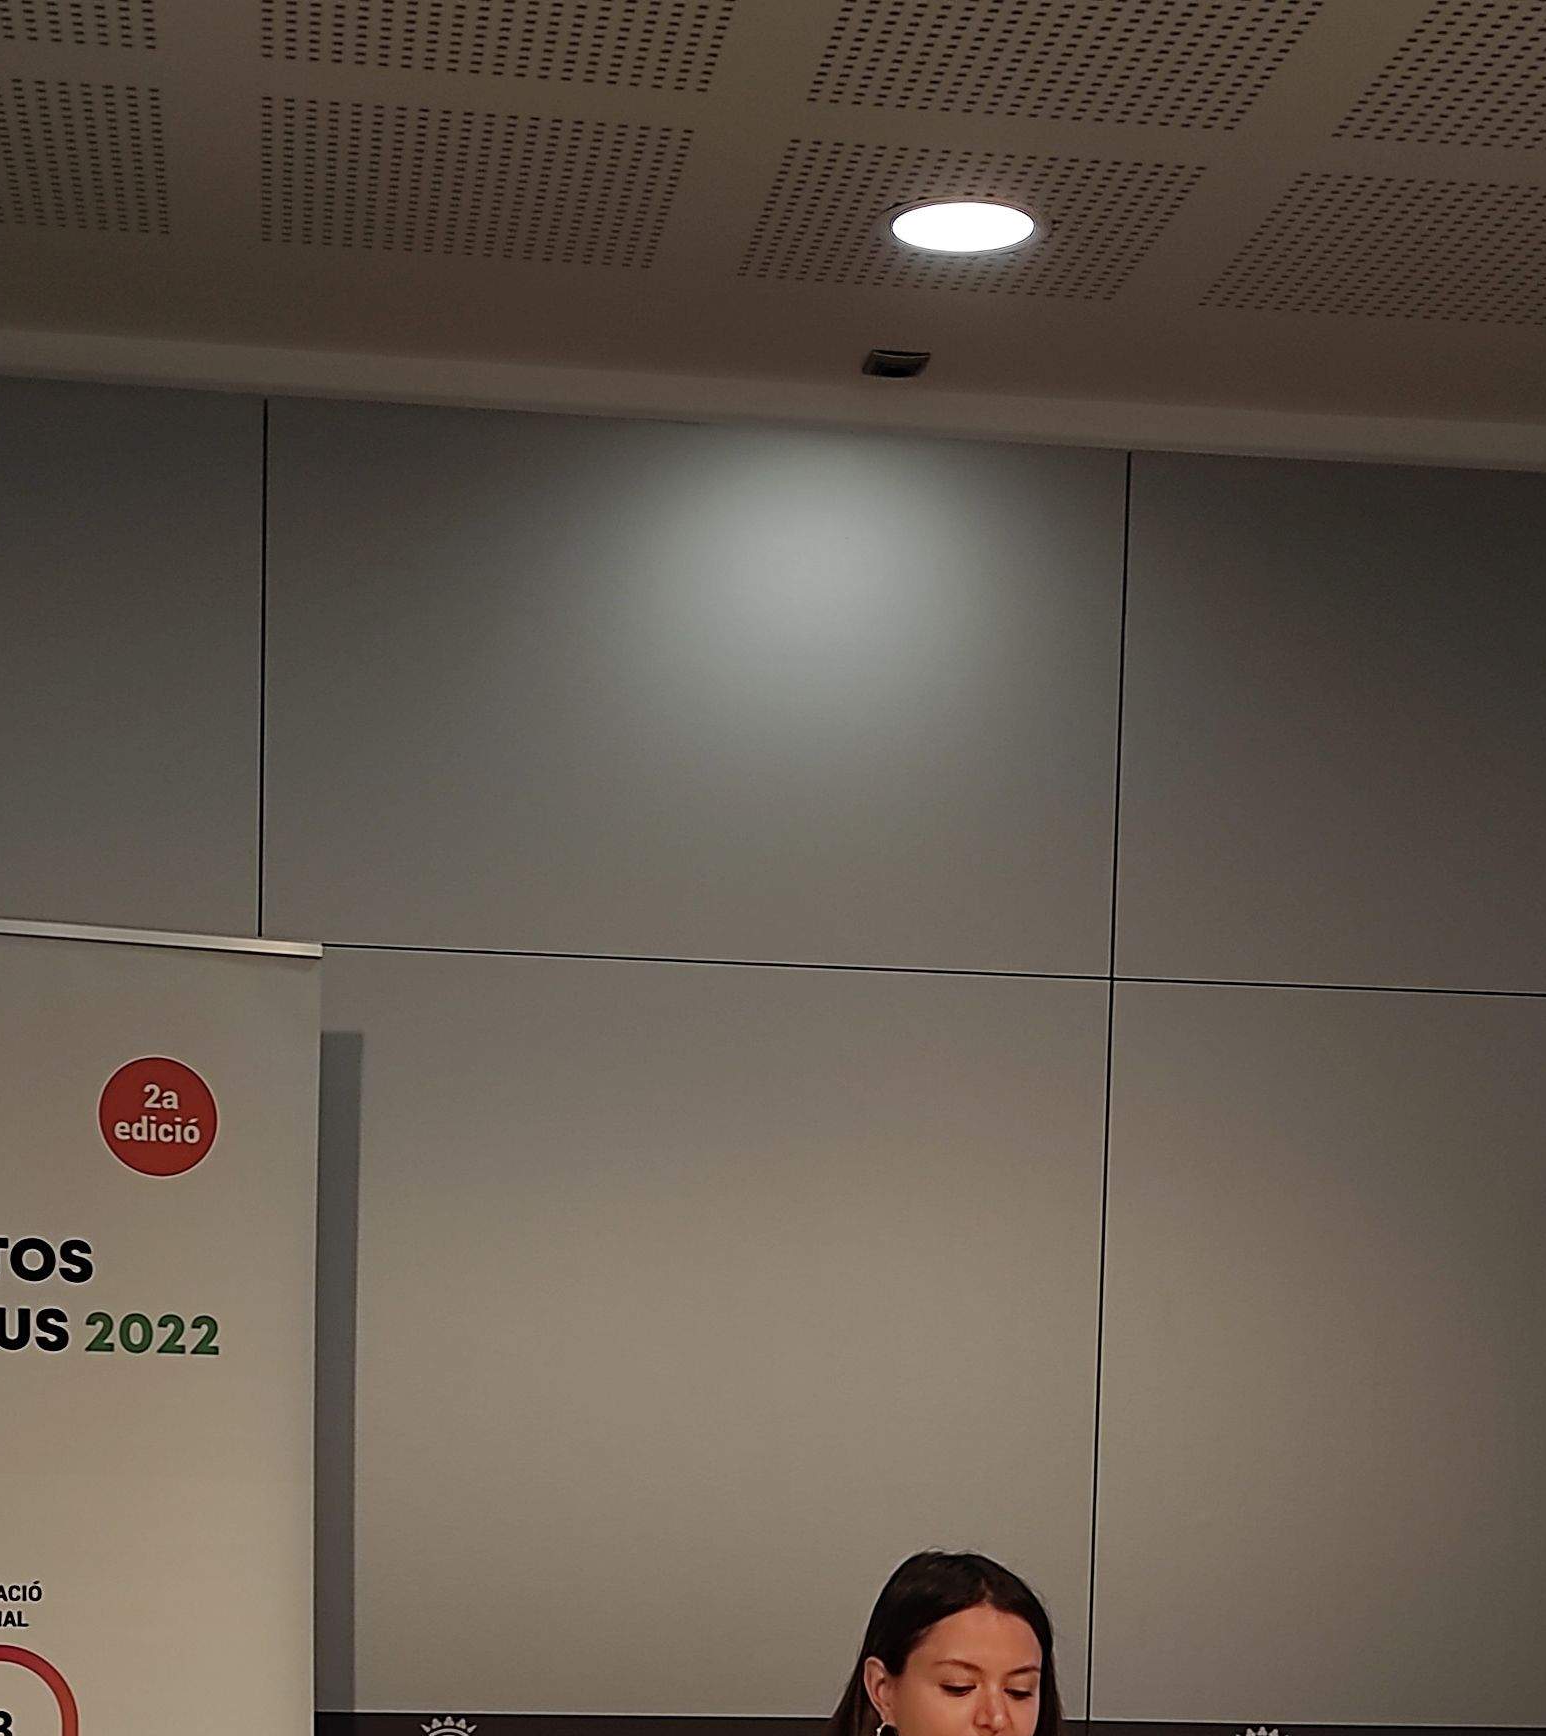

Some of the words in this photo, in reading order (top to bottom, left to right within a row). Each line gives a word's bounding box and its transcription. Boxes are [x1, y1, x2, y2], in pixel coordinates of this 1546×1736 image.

[143, 1085, 179, 1112] 2a
[114, 1115, 201, 1146] edició
[85, 1312, 220, 1356] 2022
